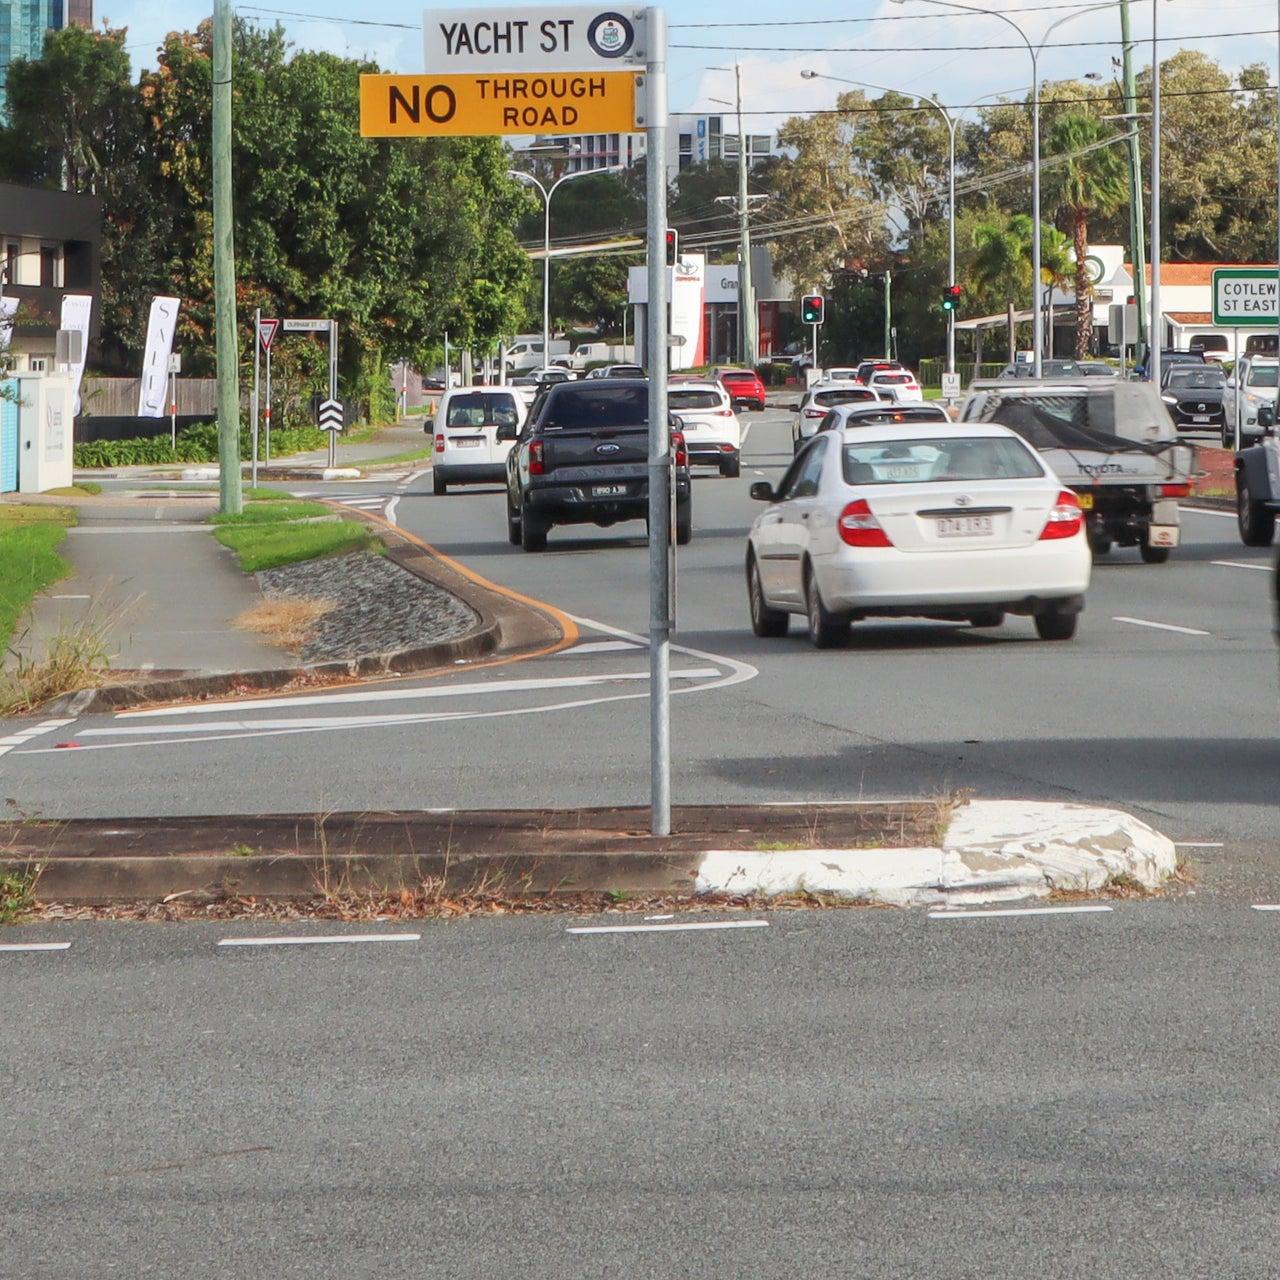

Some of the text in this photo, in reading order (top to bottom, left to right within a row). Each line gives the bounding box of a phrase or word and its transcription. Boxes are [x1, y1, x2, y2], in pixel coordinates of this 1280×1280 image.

[439, 20, 574, 55] YACHT ST
[389, 77, 607, 124] NO THROUGH
[503, 106, 579, 127] ROAD
[1224, 283, 1277, 296] COTLEW
[1224, 300, 1277, 312] ST EAST
